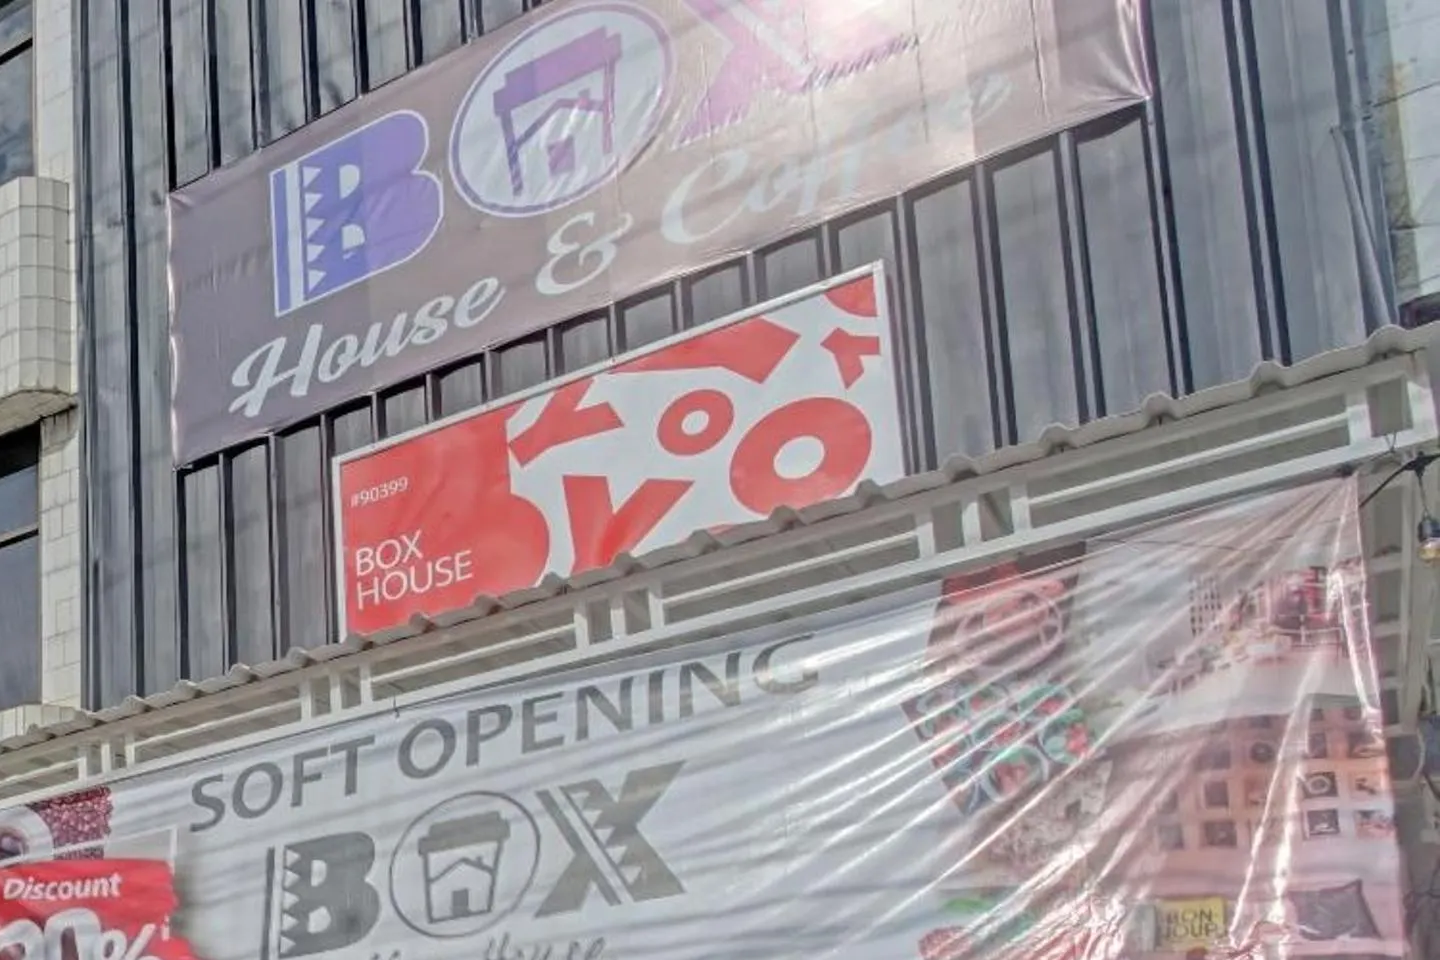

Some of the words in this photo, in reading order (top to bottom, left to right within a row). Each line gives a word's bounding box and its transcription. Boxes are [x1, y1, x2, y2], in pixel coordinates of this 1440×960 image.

[229, 276, 506, 418] House
[535, 211, 633, 295] &
[351, 476, 409, 508] #90399
[355, 528, 424, 577] BOX
[357, 549, 474, 610] HOUSE
[190, 734, 375, 833] SOFT
[397, 634, 821, 780] OPENING
[3, 873, 123, 900] Discount
